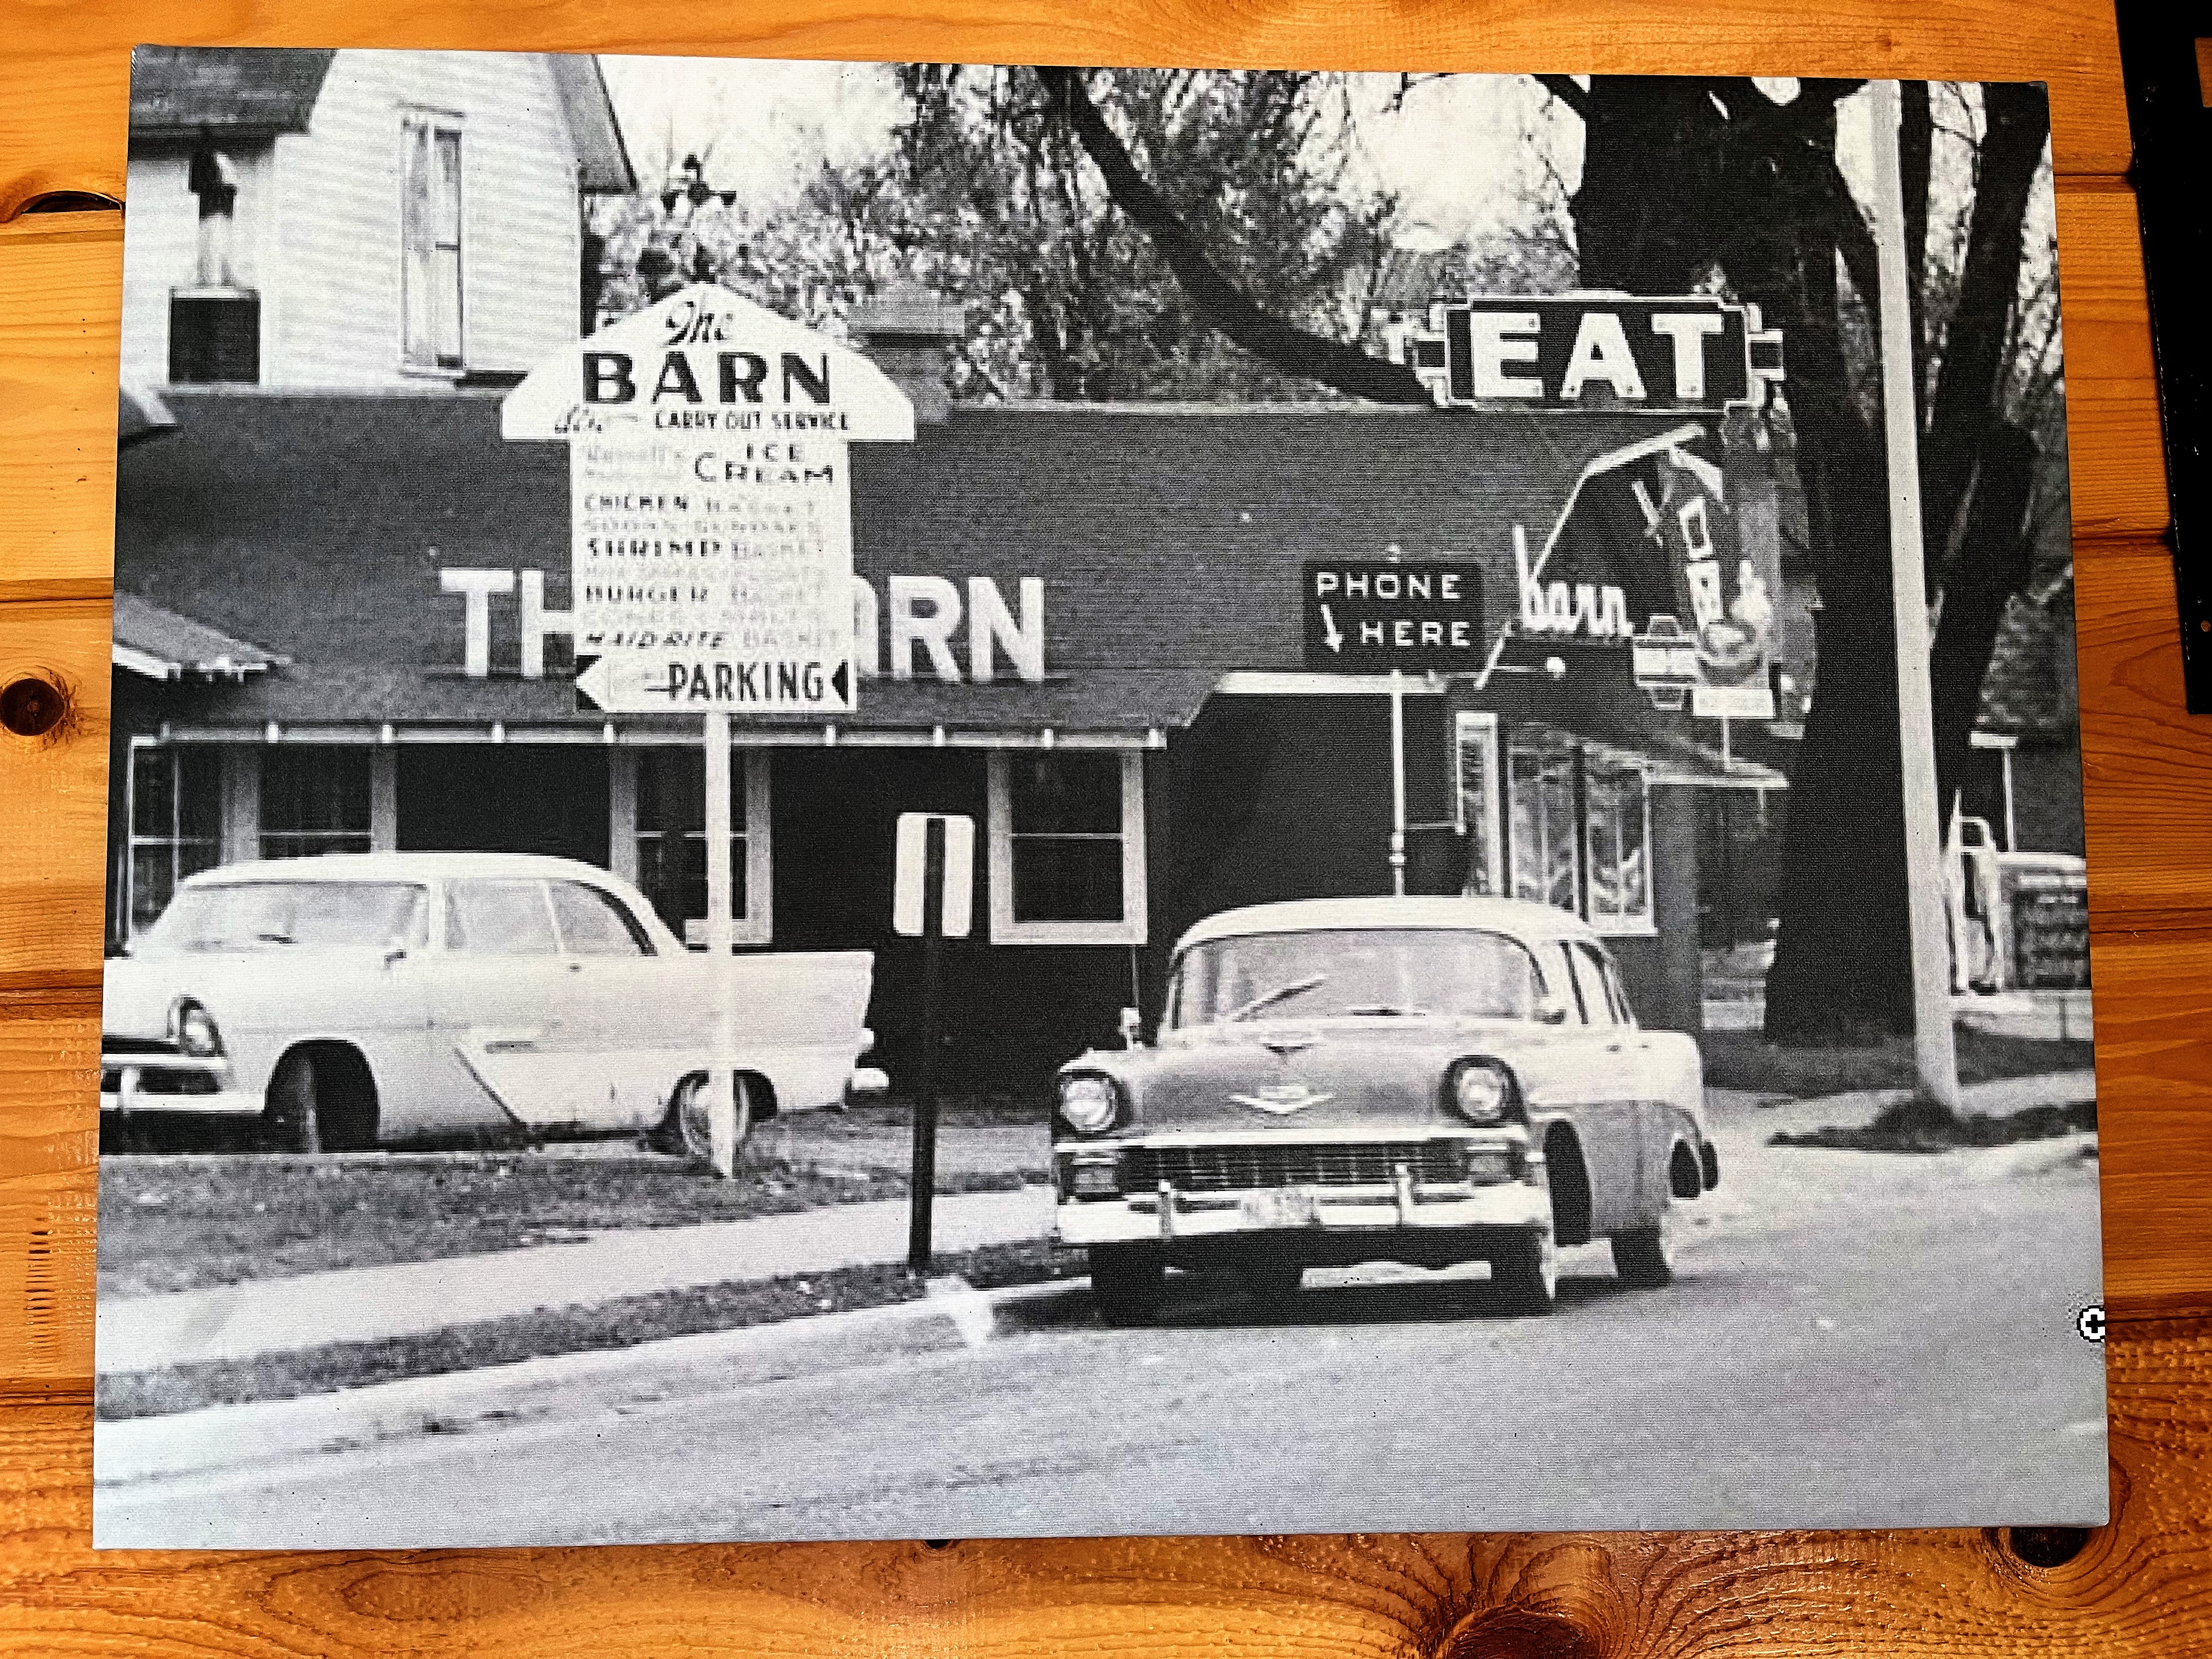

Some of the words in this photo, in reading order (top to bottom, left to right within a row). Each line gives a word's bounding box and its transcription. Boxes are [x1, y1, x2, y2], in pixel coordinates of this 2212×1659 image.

[1469, 312, 1724, 399] EAT
[582, 351, 831, 405] BARN
[654, 410, 718, 430] CARRY
[725, 410, 761, 430] OUT
[771, 410, 849, 431] SERVICE
[746, 442, 801, 462] ICE
[694, 451, 834, 486] CREAM
[584, 495, 689, 512] CHICKEN
[587, 537, 721, 557] SHRIMP
[586, 584, 708, 602] BURGER
[1317, 572, 1462, 599] PHONE
[1361, 620, 1471, 646] HERE
[668, 661, 825, 702] PARKING
